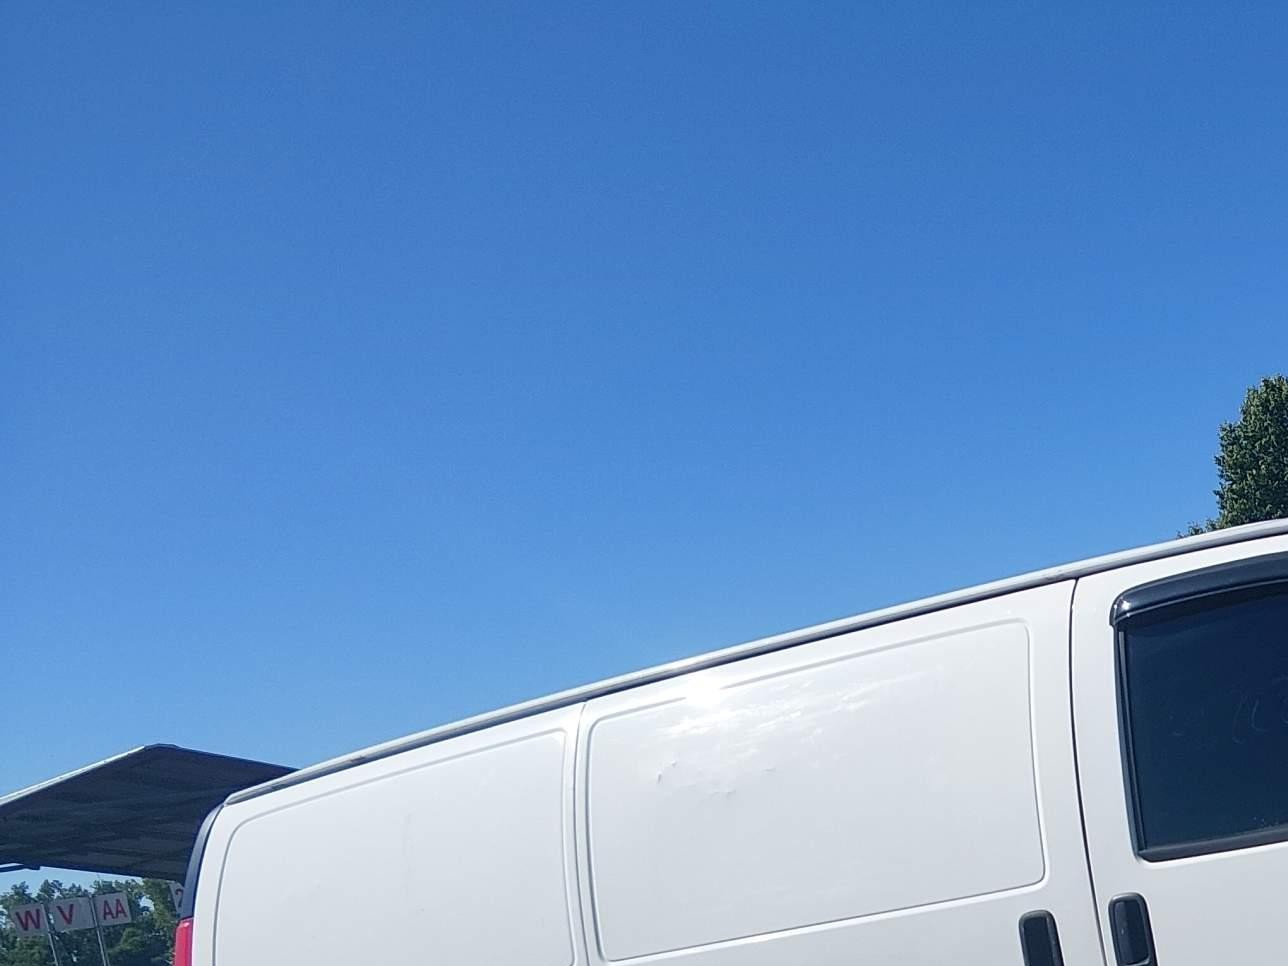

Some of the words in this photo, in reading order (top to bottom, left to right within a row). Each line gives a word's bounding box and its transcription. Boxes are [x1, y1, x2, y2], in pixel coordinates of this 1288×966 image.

[15, 908, 41, 931] W
[56, 903, 74, 925] V
[103, 898, 127, 919] AA
